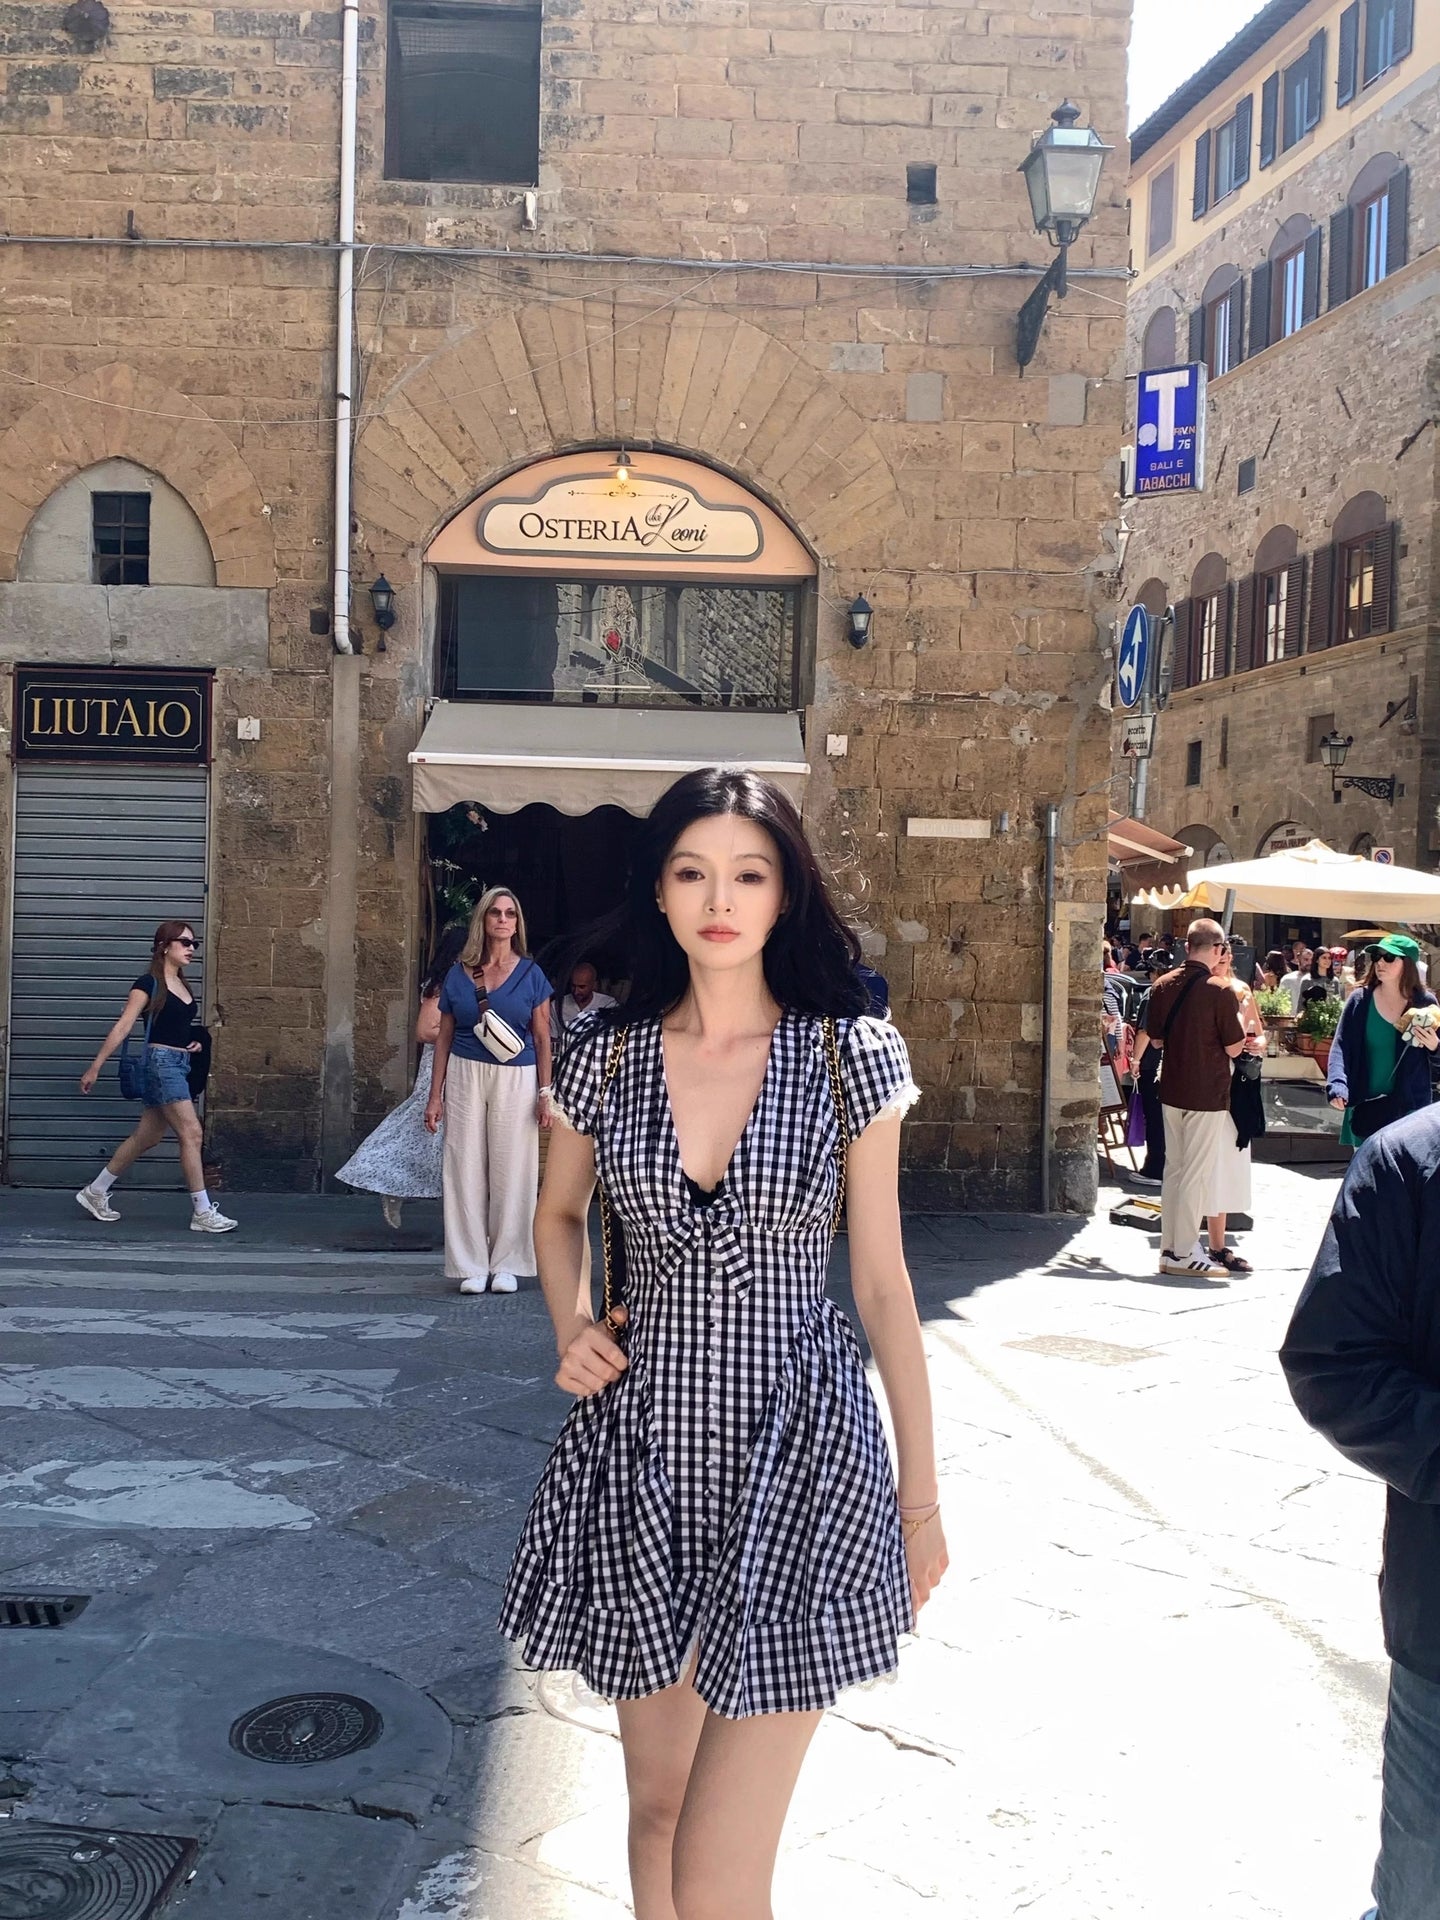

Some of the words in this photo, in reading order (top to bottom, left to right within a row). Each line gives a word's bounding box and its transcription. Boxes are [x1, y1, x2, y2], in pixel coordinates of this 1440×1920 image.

[1145, 370, 1190, 452] T
[1139, 473, 1191, 490] TABACCHI
[1150, 461, 1173, 471] SALI
[1177, 459, 1184, 468] E
[519, 512, 642, 541] OSTERIA
[641, 497, 708, 552] Leoni
[30, 698, 192, 737] LIUTAIO
